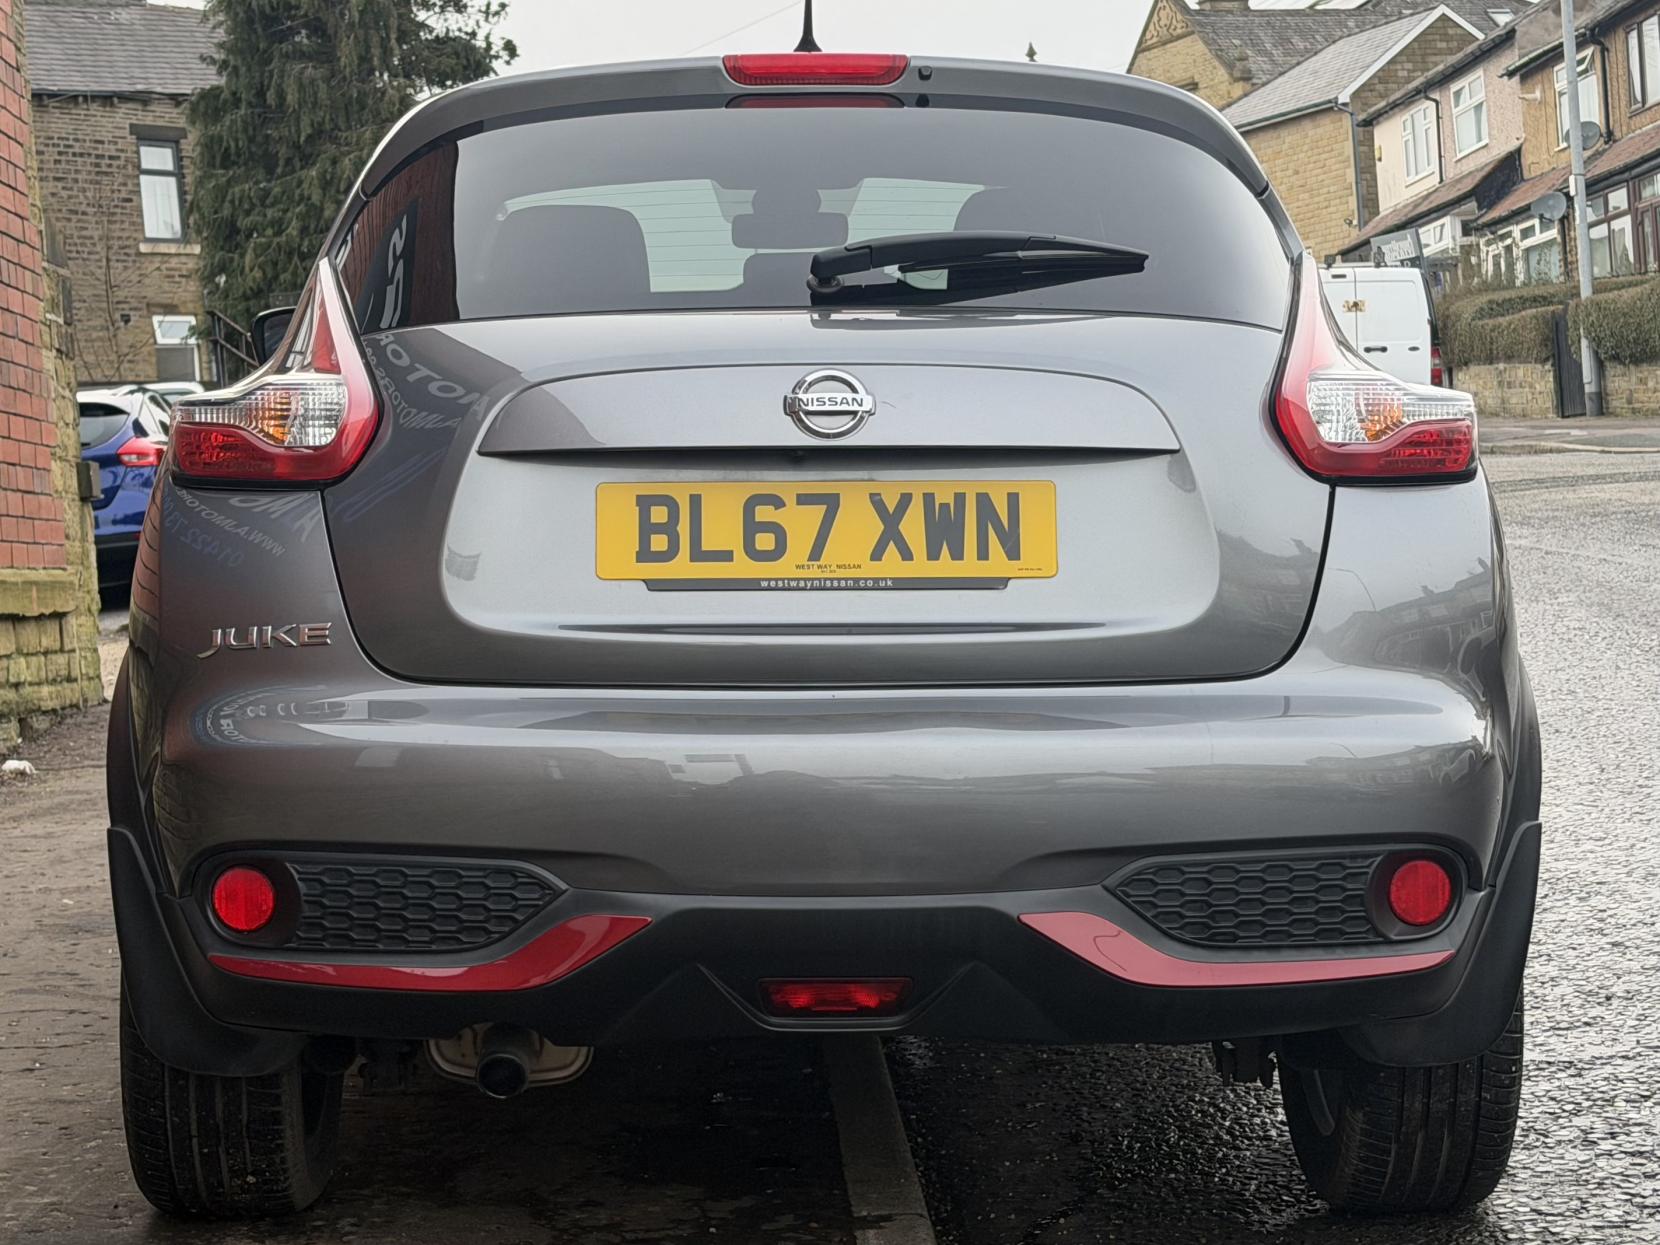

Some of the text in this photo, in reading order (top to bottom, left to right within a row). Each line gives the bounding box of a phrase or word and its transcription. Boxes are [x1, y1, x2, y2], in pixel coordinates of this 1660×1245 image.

[799, 396, 864, 408] NISSAN
[634, 491, 1022, 564] BL67 XWN
[760, 578, 894, 589] westwaynissan.co.uk
[195, 621, 333, 659] JUKE
